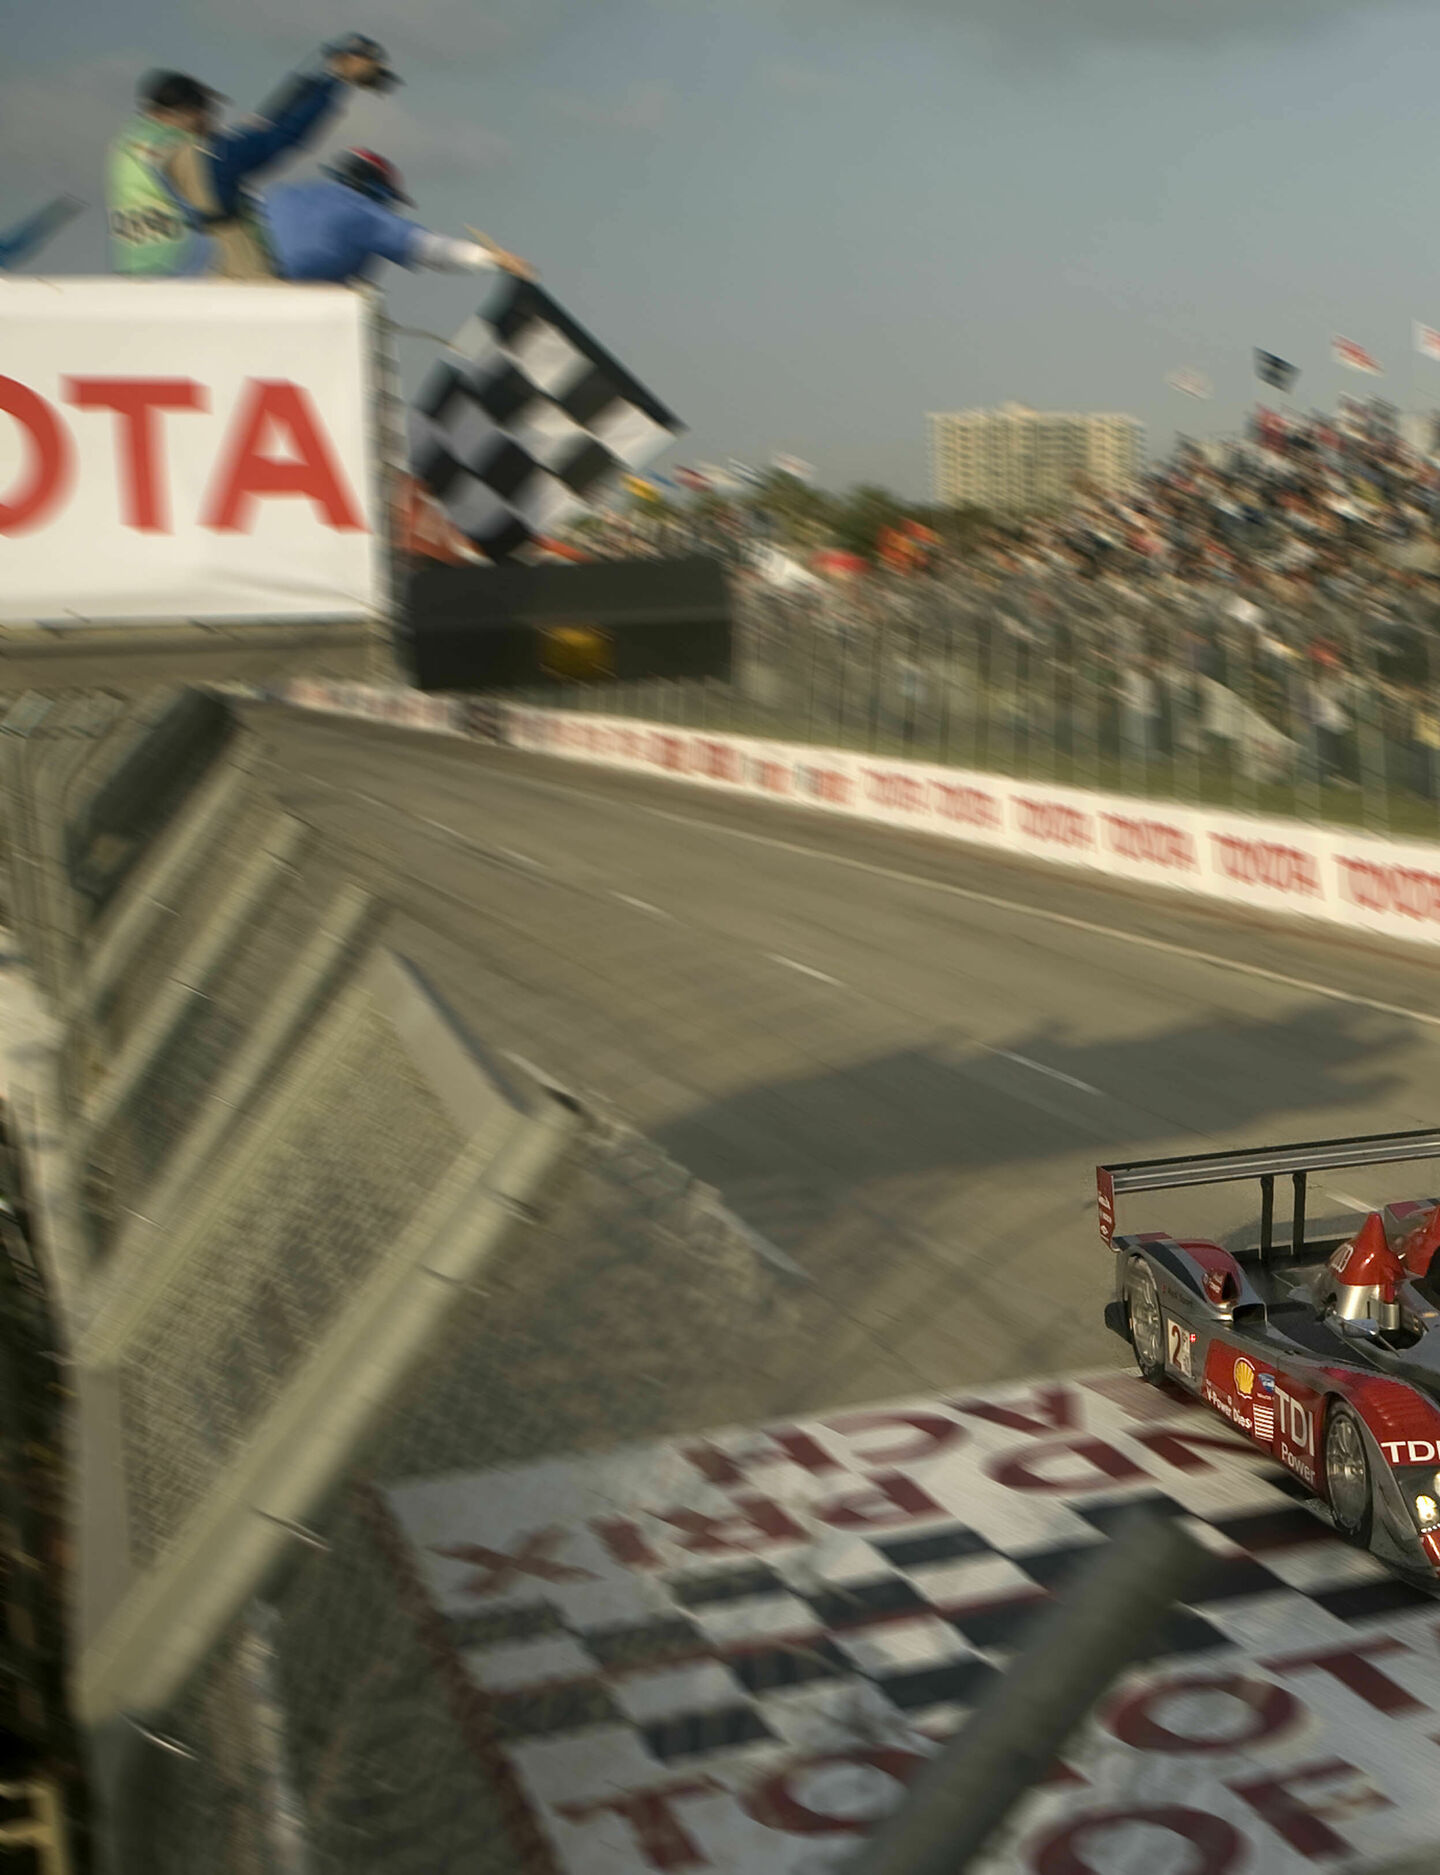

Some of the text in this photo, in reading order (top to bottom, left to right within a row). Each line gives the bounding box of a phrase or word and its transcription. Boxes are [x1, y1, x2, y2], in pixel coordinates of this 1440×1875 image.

[1172, 1325, 1182, 1370] 2
[1274, 1385, 1315, 1457] TDI
[1281, 1441, 1316, 1484] Power
